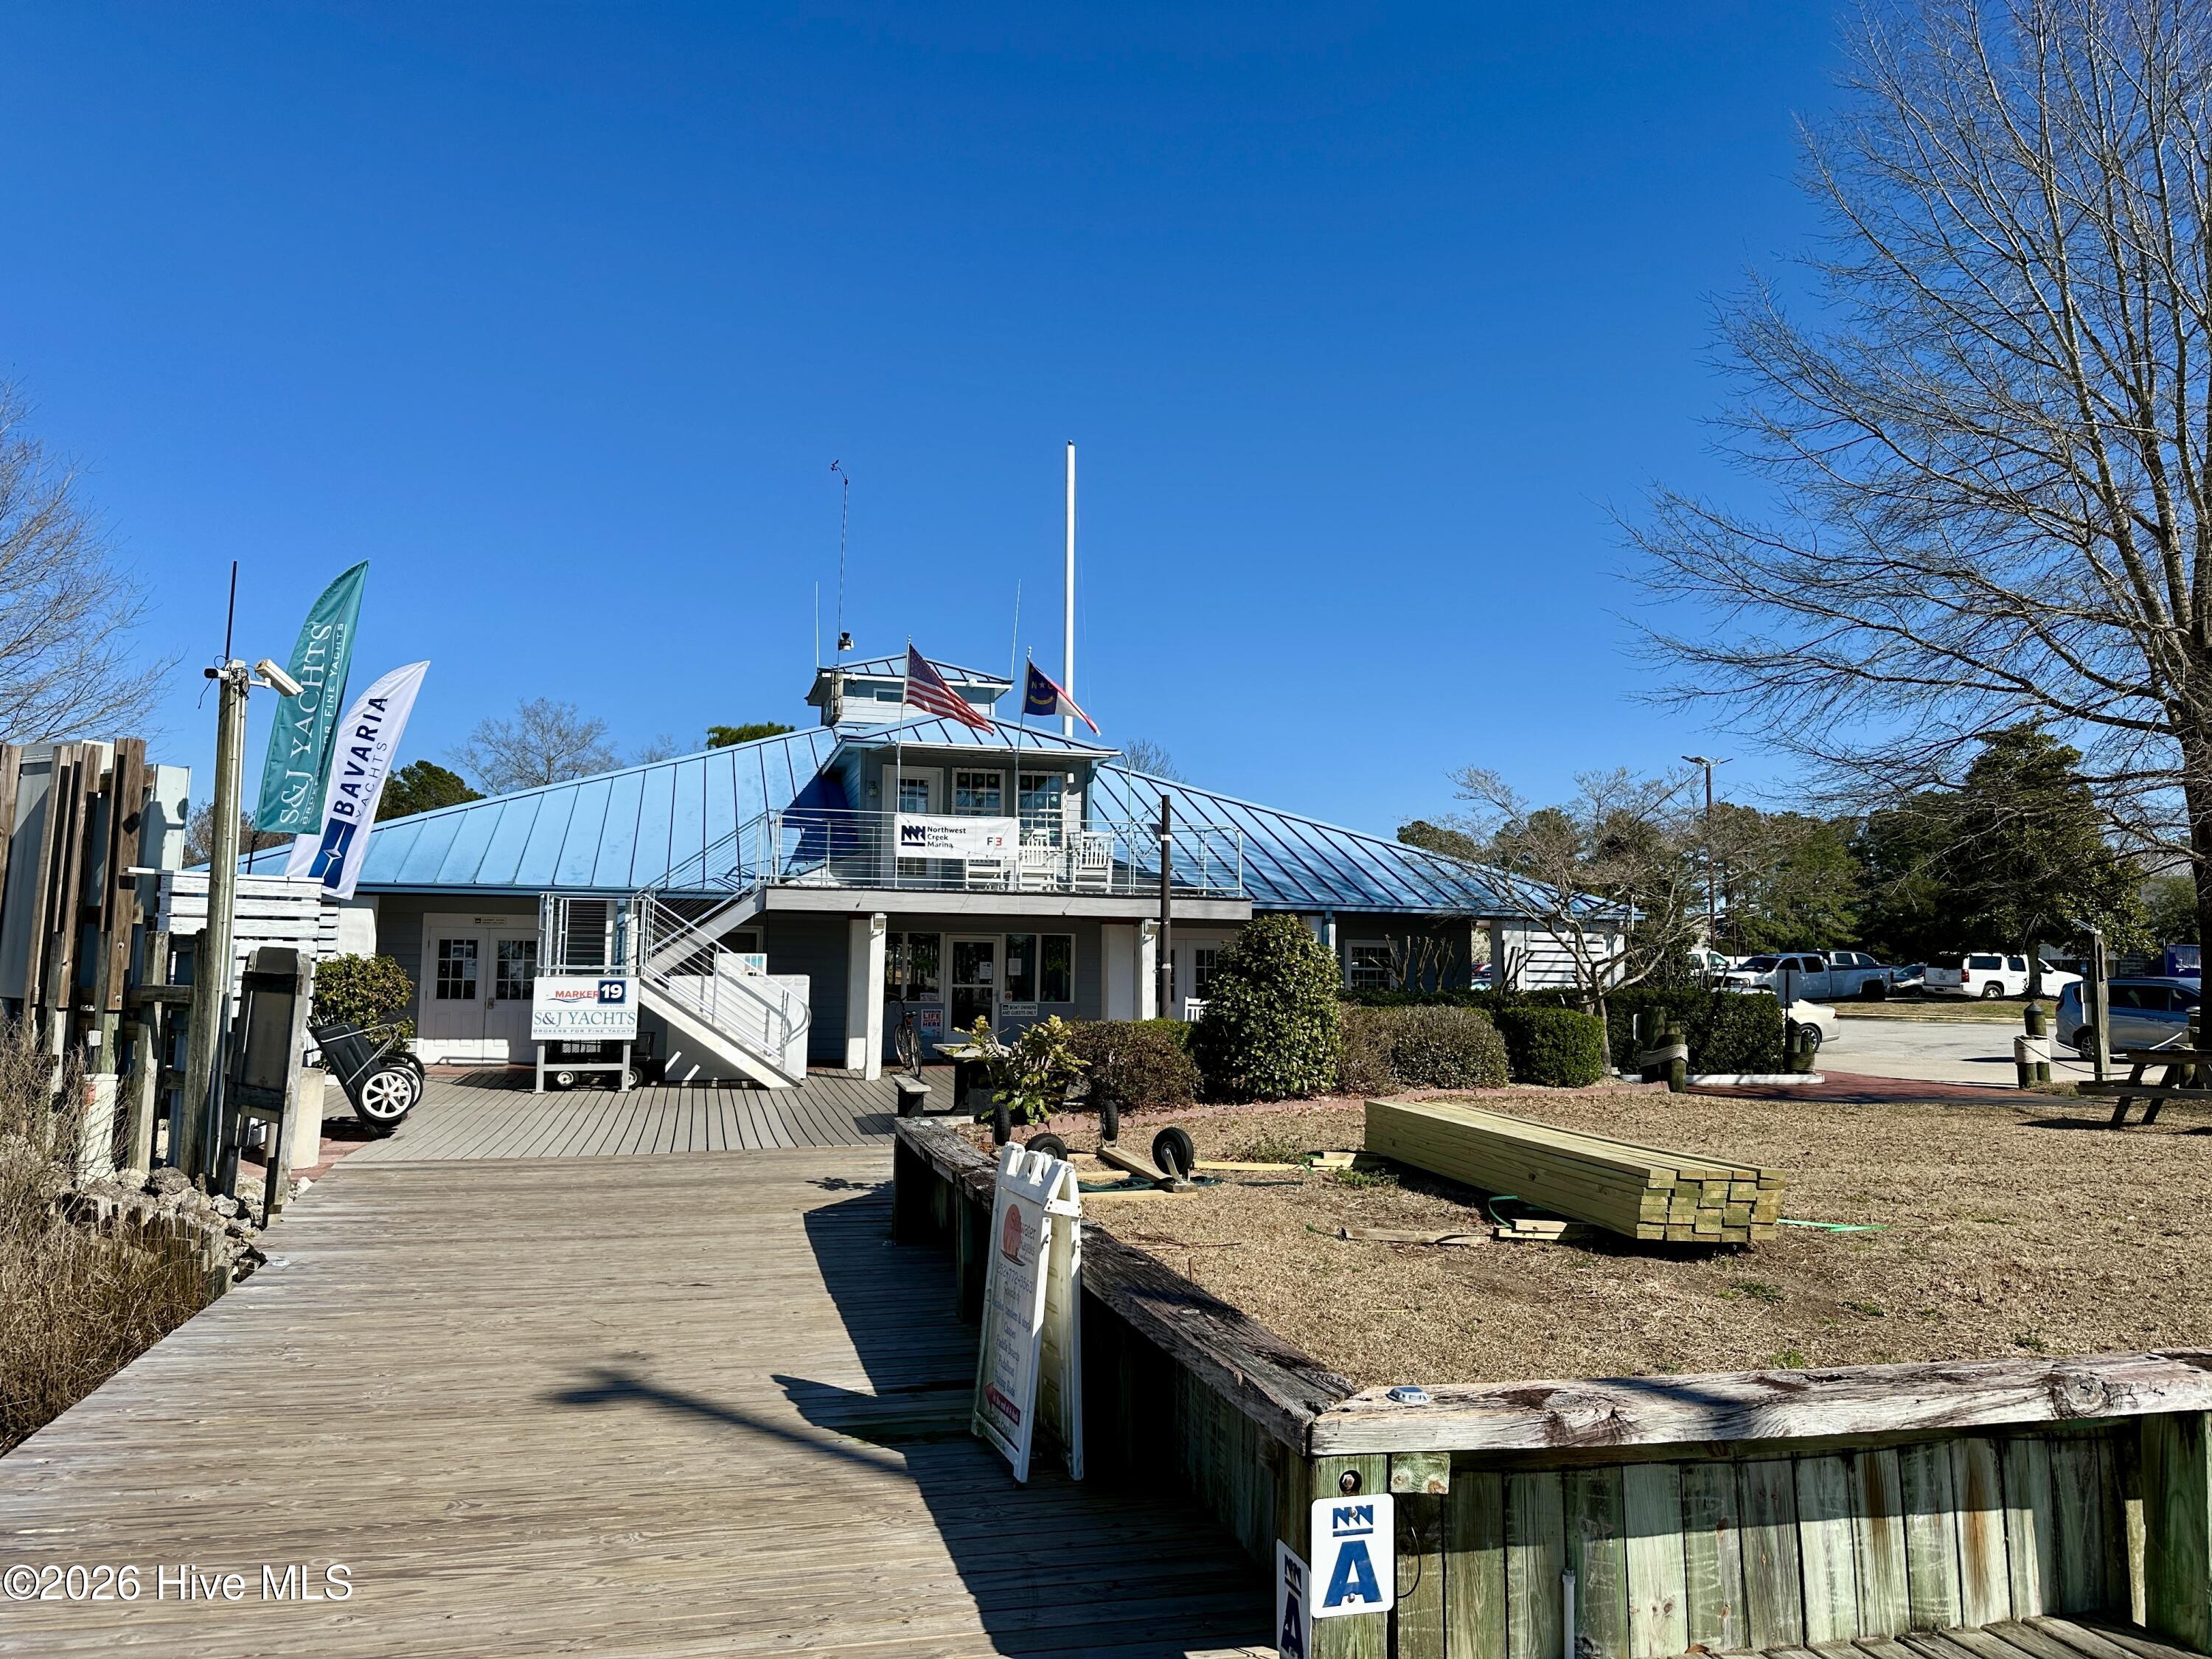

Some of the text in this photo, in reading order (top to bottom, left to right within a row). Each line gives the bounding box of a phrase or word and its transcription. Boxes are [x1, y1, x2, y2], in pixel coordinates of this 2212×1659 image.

[329, 623, 344, 678] YACHTS
[280, 625, 332, 824] S&J YACHTS
[324, 685, 335, 717] FINE
[333, 698, 388, 817] BAVARIA
[355, 742, 387, 818] YACHTS
[534, 1011, 636, 1027] S&J YACHTS
[555, 984, 623, 999] MARKER 19
[1322, 1540, 1383, 1608] A
[1280, 1591, 1304, 1659] A
